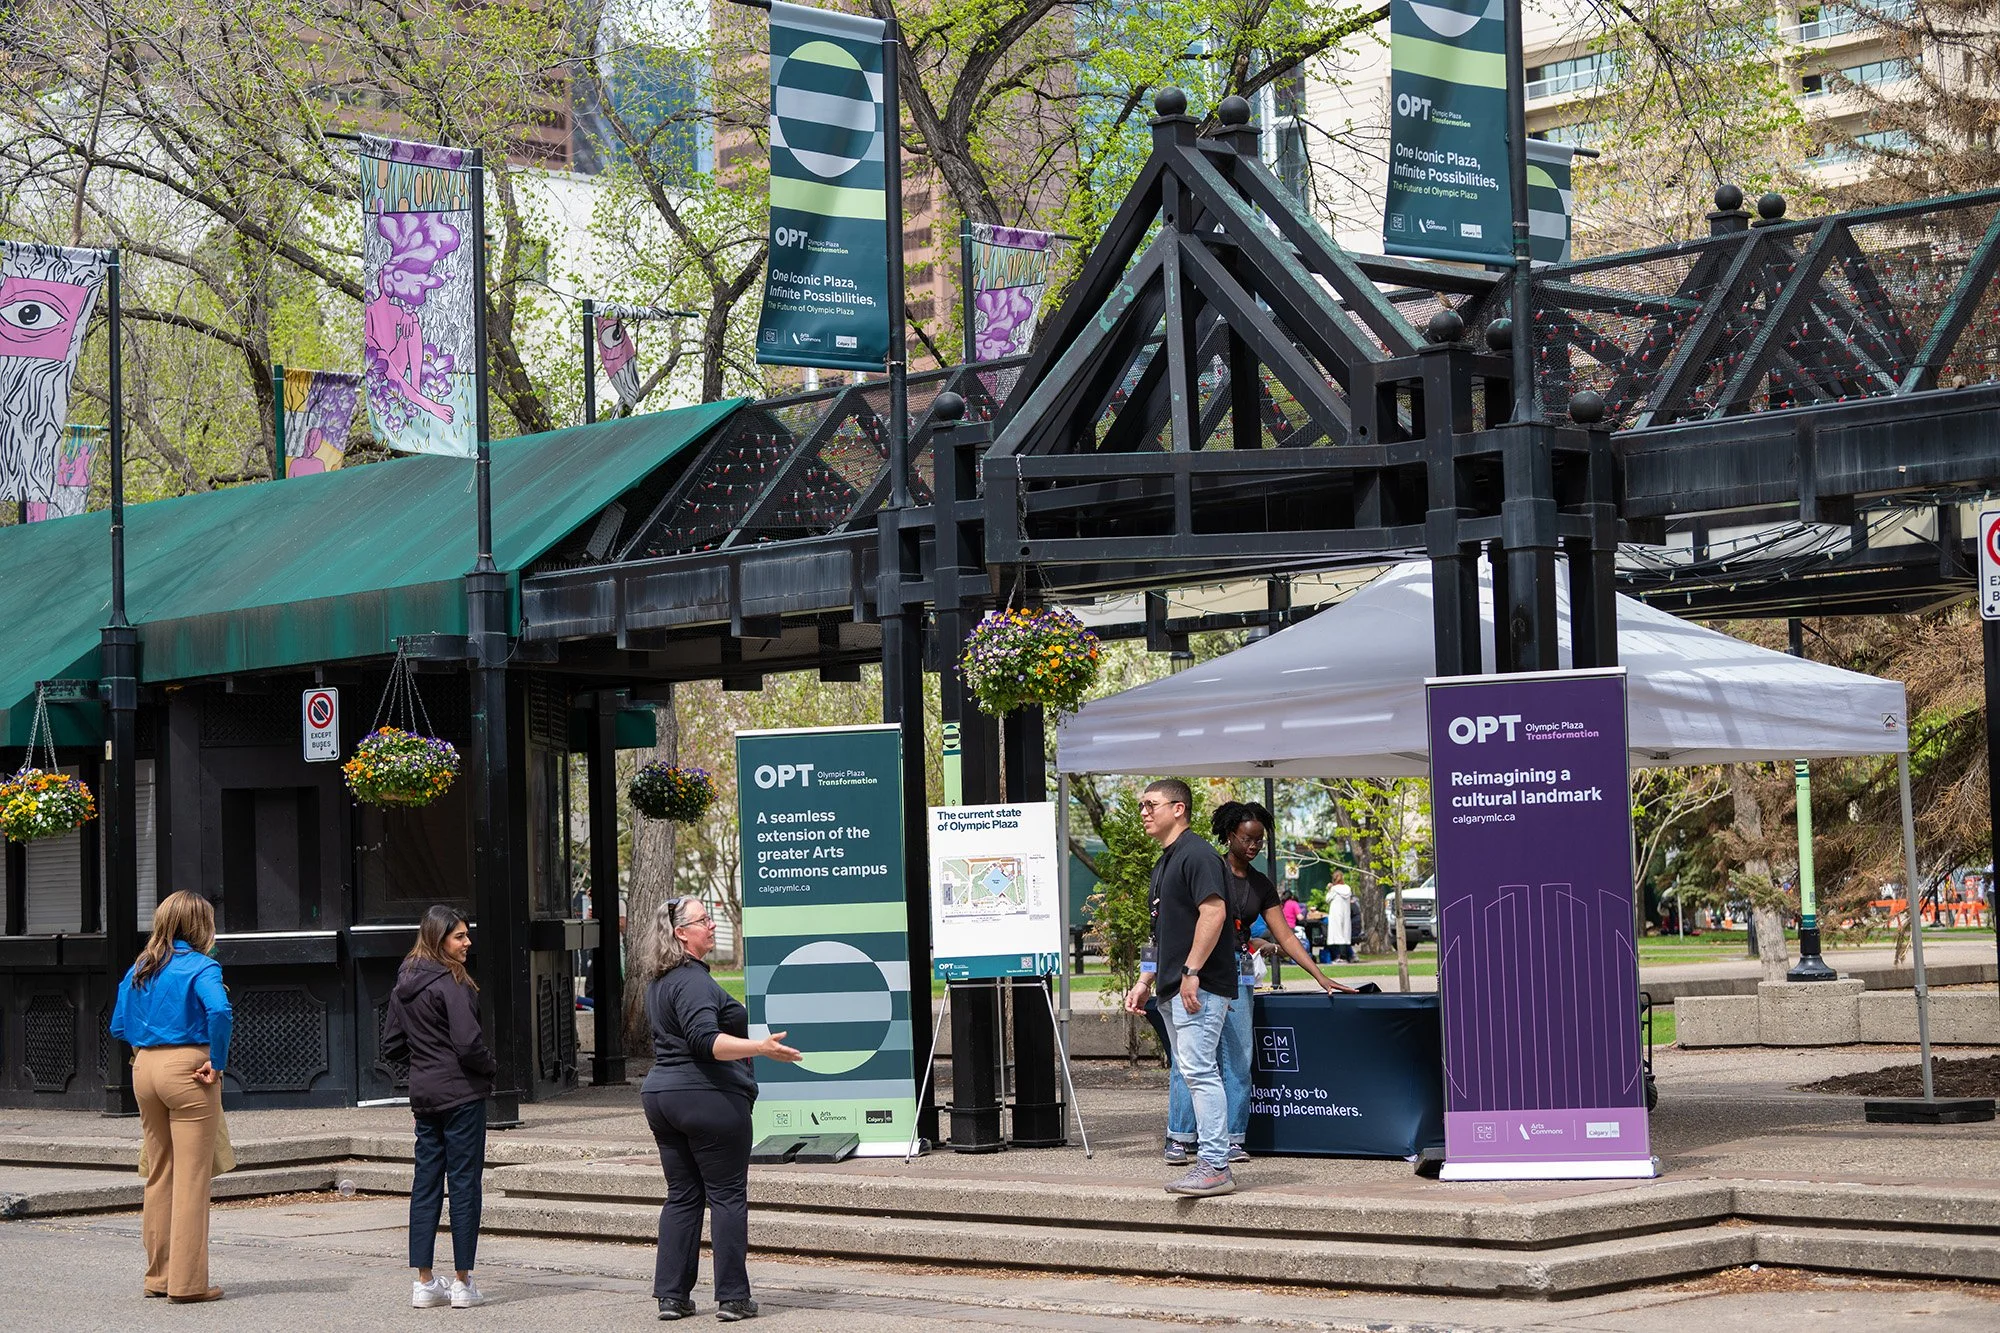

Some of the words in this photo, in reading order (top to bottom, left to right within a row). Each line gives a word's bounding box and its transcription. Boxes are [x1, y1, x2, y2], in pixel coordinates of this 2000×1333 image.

[1397, 93, 1432, 121] OPT
[1431, 108, 1448, 118] Olympic
[1448, 111, 1462, 119] Plaza
[1431, 116, 1471, 128] Transformation
[1395, 143, 1414, 159] One
[1414, 147, 1445, 164] Iconic
[1447, 152, 1481, 170] Plaza,
[1394, 161, 1426, 180] Infinite
[1428, 168, 1499, 191] Possibilities,
[1393, 180, 1403, 190] The
[1403, 183, 1422, 194] Future
[1423, 186, 1431, 195] of
[1431, 187, 1459, 199] Olympic
[1460, 191, 1478, 200] Plaza
[775, 226, 808, 250] OPT
[808, 239, 825, 247] Olympic
[807, 245, 849, 254] Transformation
[772, 269, 789, 282] One
[789, 271, 821, 286] Iconic
[823, 275, 858, 291] Plaza,
[769, 285, 800, 300] Infinite
[803, 290, 876, 307] Possibilities,
[768, 301, 776, 309] The
[777, 302, 797, 312] Future
[806, 305, 835, 315] Olympic
[836, 307, 854, 315] Plaza
[311, 731, 332, 739] EXCEPT
[1448, 714, 1522, 745] OPT
[1525, 723, 1559, 733] Olympic
[1526, 730, 1599, 741] Transformation
[754, 763, 815, 789] OPT
[817, 770, 845, 779] Olympic
[818, 777, 878, 786] Transformation
[1451, 768, 1556, 787] Reimagining
[1560, 769, 1571, 781] a
[1452, 791, 1517, 807] cultural
[1521, 786, 1602, 804] landmark
[756, 812, 768, 824] A
[770, 810, 836, 824] seamless
[937, 811, 956, 820] The
[957, 810, 994, 819] current
[996, 808, 1021, 818] state
[1452, 813, 1516, 825] calgarymlc.ca
[937, 822, 949, 831] of
[949, 820, 991, 832] Olympic
[992, 820, 1018, 829] Plaza
[757, 828, 825, 843] extension
[828, 826, 844, 840] of
[846, 826, 870, 839] the
[757, 847, 810, 863] greater
[812, 846, 844, 859] Arts
[758, 866, 829, 879] Commons
[832, 864, 888, 877] campus
[758, 884, 810, 894] calgarymlc.ca
[1250, 1084, 1292, 1101] lgary's
[1293, 1087, 1328, 1101] go-to
[1249, 1101, 1280, 1117] ilding
[1283, 1102, 1363, 1117] placemakers.
